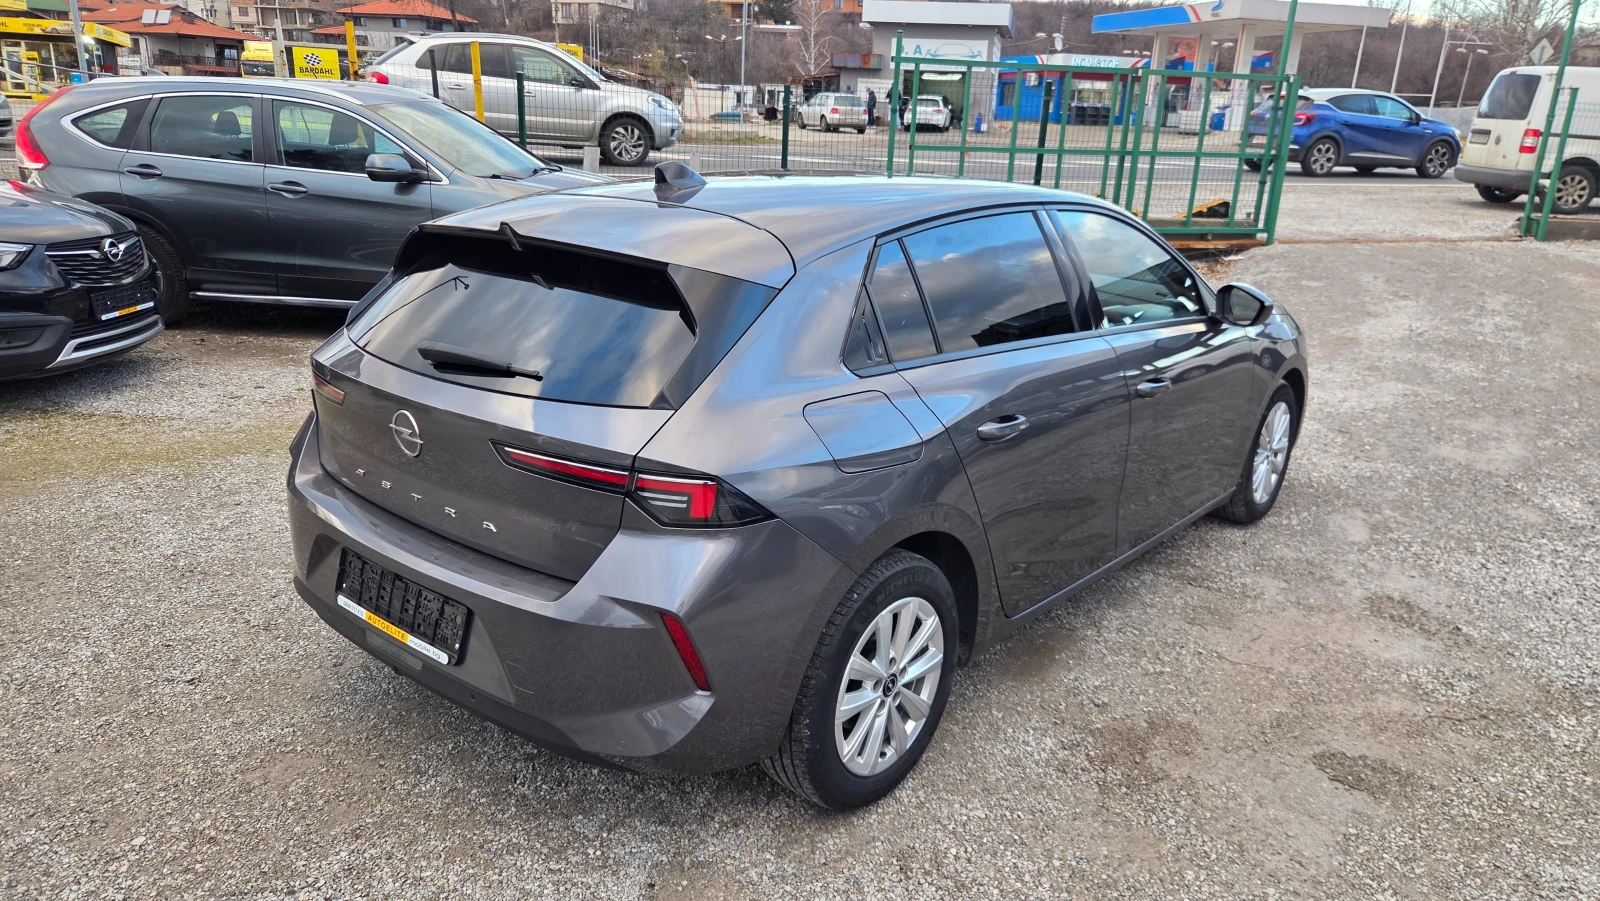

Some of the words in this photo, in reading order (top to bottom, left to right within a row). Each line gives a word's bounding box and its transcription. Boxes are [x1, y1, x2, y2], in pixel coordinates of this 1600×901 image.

[299, 66, 335, 75] BARDAHL
[1072, 57, 1092, 67] NON
[1095, 58, 1120, 68] STOP
[355, 468, 497, 532] ASTRA
[367, 614, 406, 641] AUTOELITE
